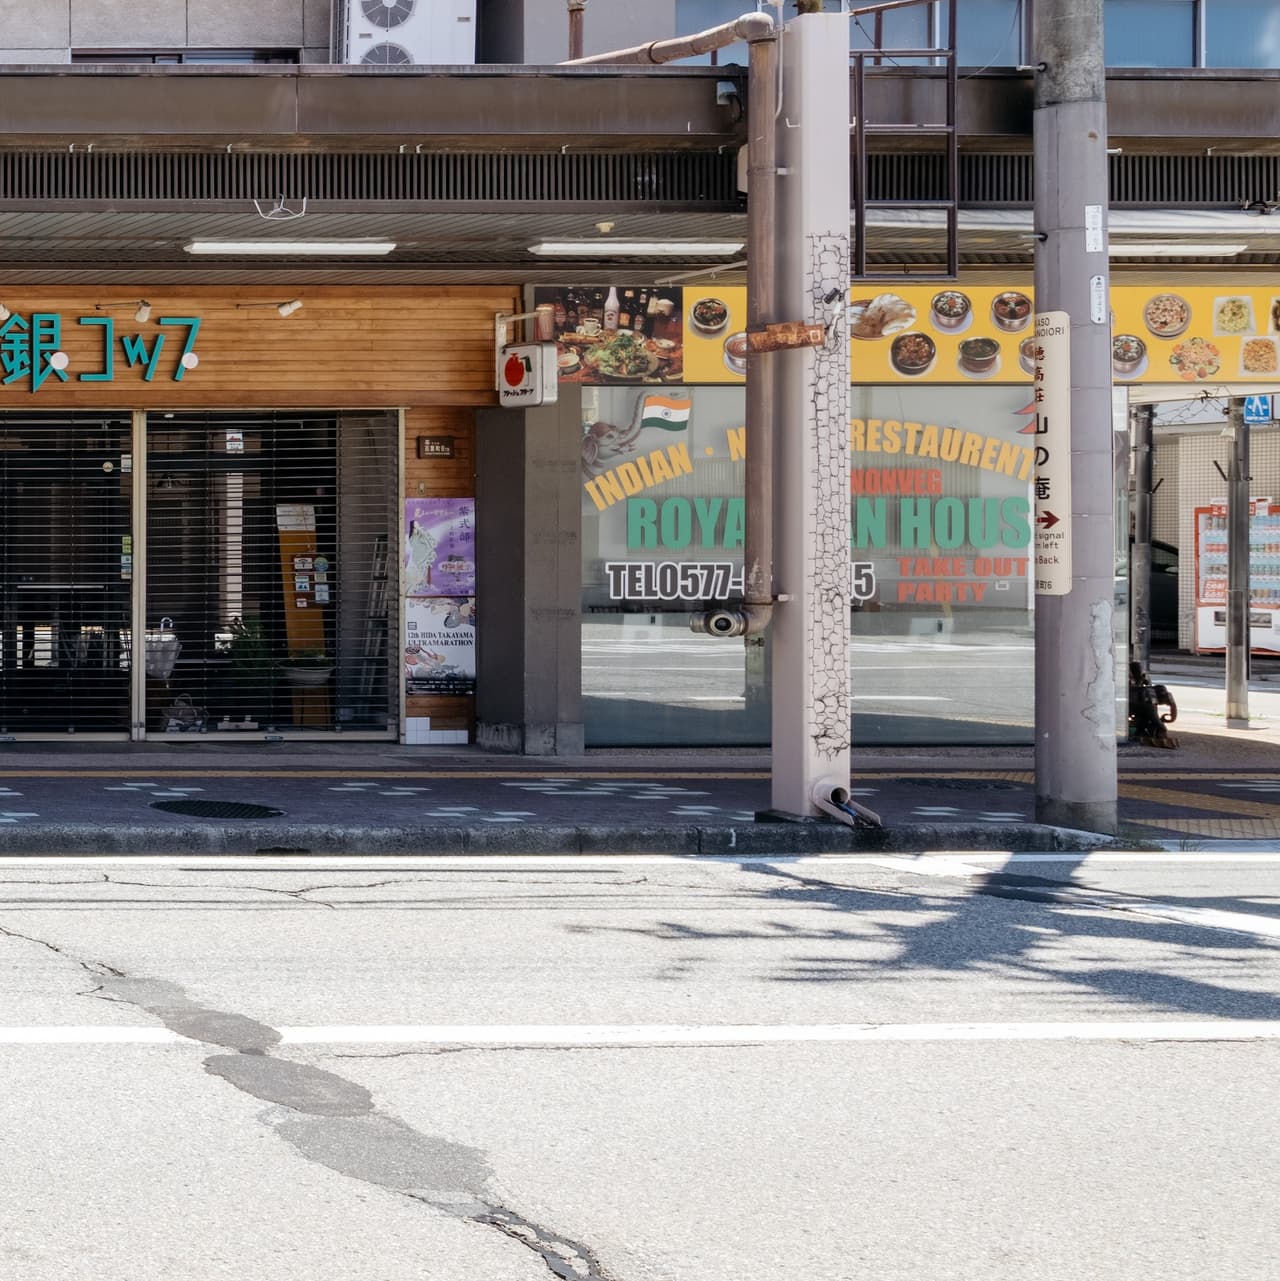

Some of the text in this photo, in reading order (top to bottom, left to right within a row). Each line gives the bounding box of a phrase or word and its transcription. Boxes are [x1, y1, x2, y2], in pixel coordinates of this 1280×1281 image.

[850, 418, 1036, 482] RESTAURENT
[584, 441, 693, 512] INDIAN
[850, 467, 943, 495] NONVEG
[626, 496, 745, 550] ROYA
[900, 496, 1032, 550] HOUS
[1038, 531, 1065, 541] signal
[1042, 542, 1059, 550] left
[897, 556, 1030, 577] TAKE OUT
[897, 582, 989, 603] PARTY
[407, 631, 474, 639] 12th HIDA TAKAYAMA
